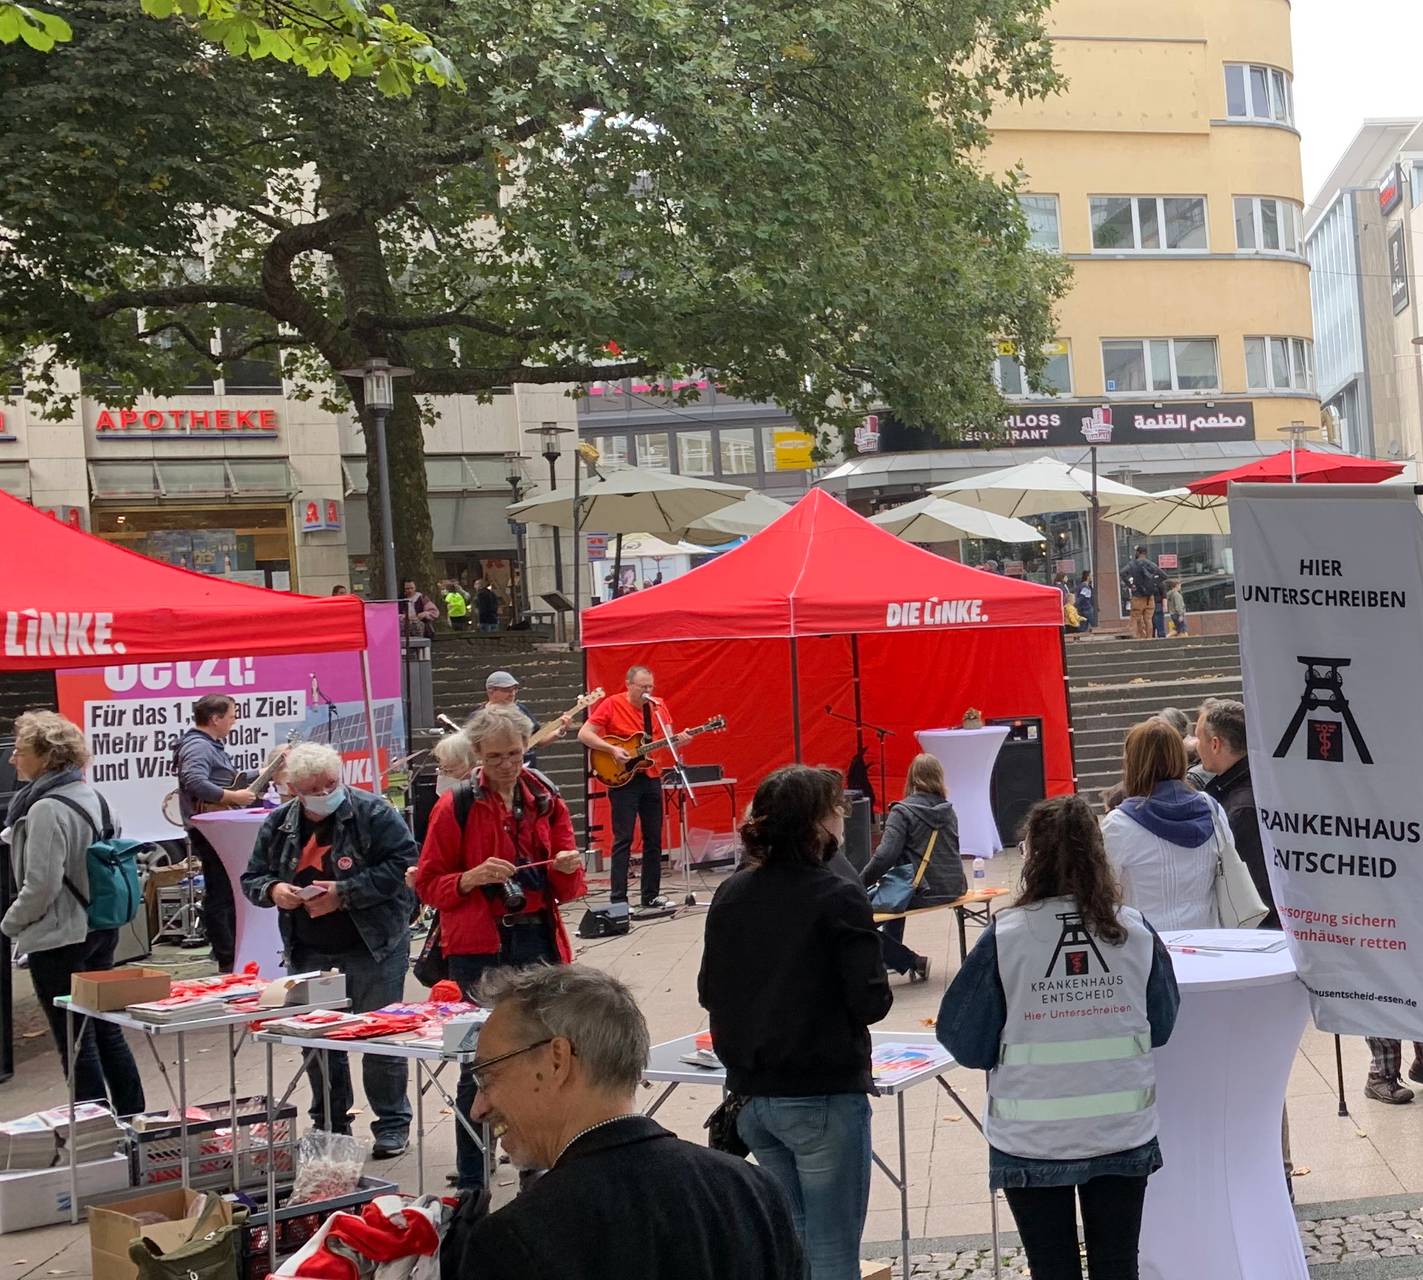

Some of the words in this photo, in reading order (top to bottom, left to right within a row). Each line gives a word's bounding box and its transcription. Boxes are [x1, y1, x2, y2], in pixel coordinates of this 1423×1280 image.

[96, 409, 278, 431] APOTHEKE
[1299, 558, 1343, 577] HIER
[1242, 585, 1406, 608] UNTERSCHREIBEN
[886, 602, 921, 627] DIE
[924, 596, 989, 625] LINKE.
[91, 704, 127, 728] Für
[133, 704, 167, 726] das
[256, 696, 298, 718] Ziel:
[92, 732, 148, 755] Mehr
[93, 758, 129, 782] und
[1259, 807, 1421, 843] RANKENHAUS
[1341, 913, 1396, 928] sichern
[1360, 937, 1407, 950] retten
[1031, 975, 1124, 992] KRANKENHAUS
[1041, 989, 1114, 1004] ENTSCHEID
[1024, 1011, 1047, 1021] Hier
[1050, 1004, 1132, 1019] Unterschreiben
